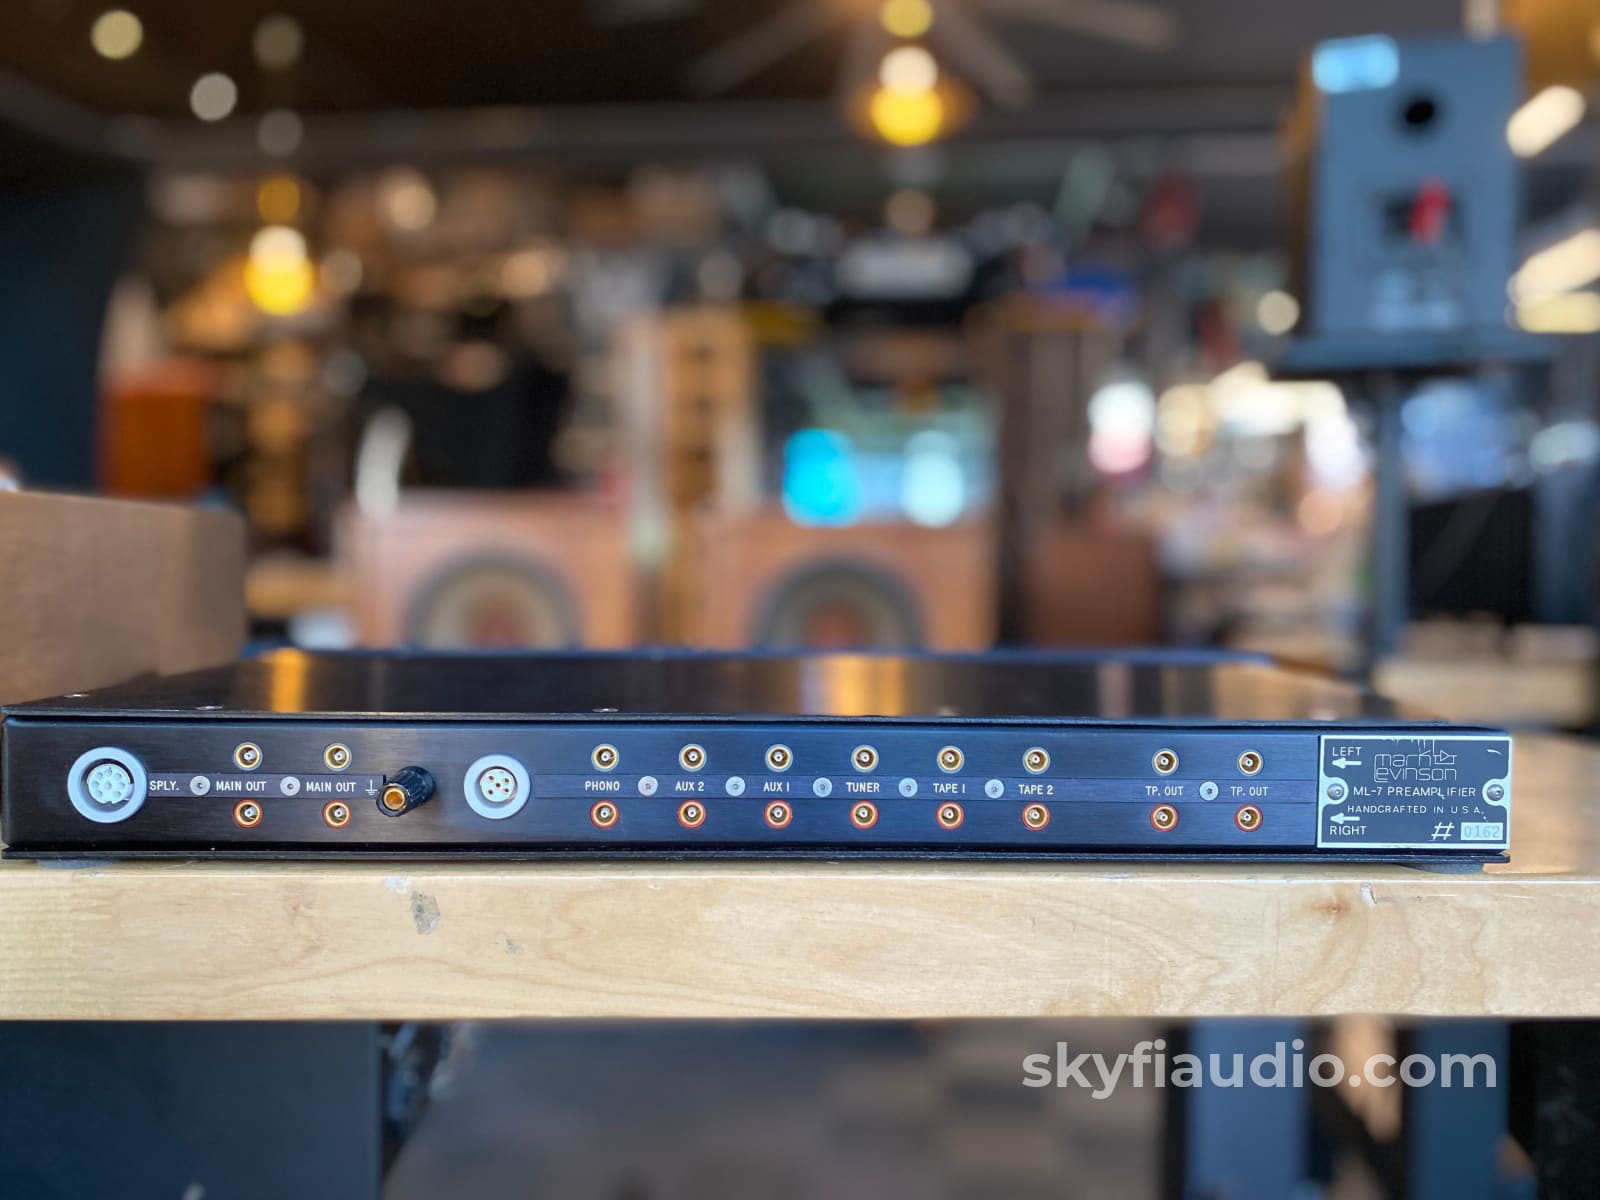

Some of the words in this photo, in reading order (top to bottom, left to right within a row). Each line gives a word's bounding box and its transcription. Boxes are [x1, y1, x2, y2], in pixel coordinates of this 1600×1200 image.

[1331, 746, 1362, 757] LEFT
[149, 780, 180, 792] SPLY.
[215, 780, 243, 791] MAIN
[246, 780, 267, 791] OUT
[306, 781, 333, 792] MAIN
[335, 781, 356, 793] OUT
[584, 780, 621, 792] PHONO
[675, 781, 695, 792] AUX
[698, 780, 705, 792] 2
[763, 782, 784, 792] AUX
[846, 782, 880, 793] TUNER
[933, 783, 959, 793] TAPE
[1018, 784, 1044, 795] TAPE
[1046, 784, 1053, 795] 2
[1145, 785, 1161, 796] TP.
[1164, 785, 1184, 796] OUT
[1230, 786, 1246, 797] TP.
[1248, 786, 1269, 797] OUT
[1353, 786, 1383, 797] ML-7
[1387, 786, 1476, 798] PREAMPLIFIER
[1347, 805, 1427, 814] HANDCRAFTED
[1433, 805, 1444, 814] IN
[1329, 825, 1367, 836] RIGHT
[1463, 824, 1502, 839] 0162
